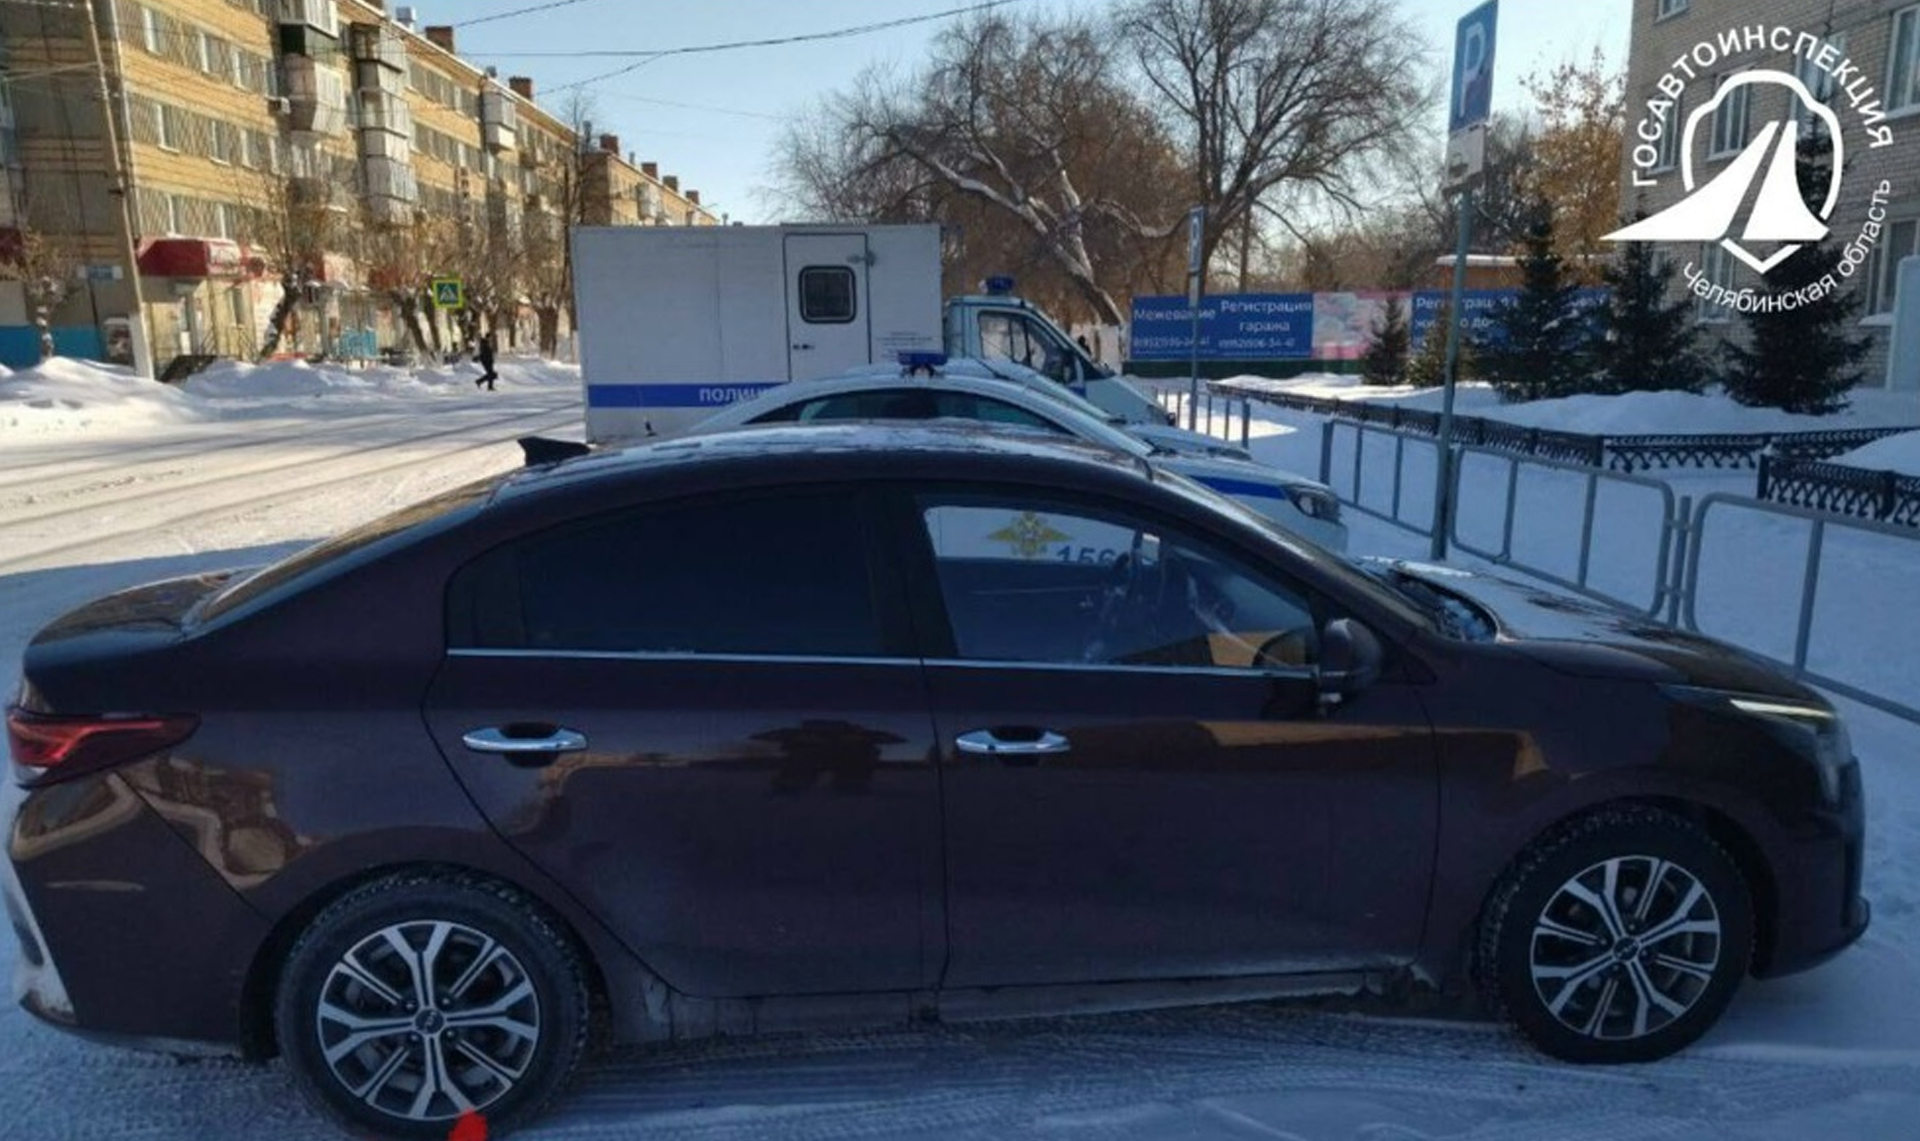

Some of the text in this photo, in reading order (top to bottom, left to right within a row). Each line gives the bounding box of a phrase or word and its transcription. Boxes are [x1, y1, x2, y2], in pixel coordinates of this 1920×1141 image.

[1459, 22, 1486, 118] P
[1133, 309, 1216, 321] Межеваие
[1220, 300, 1312, 315] Регистрация
